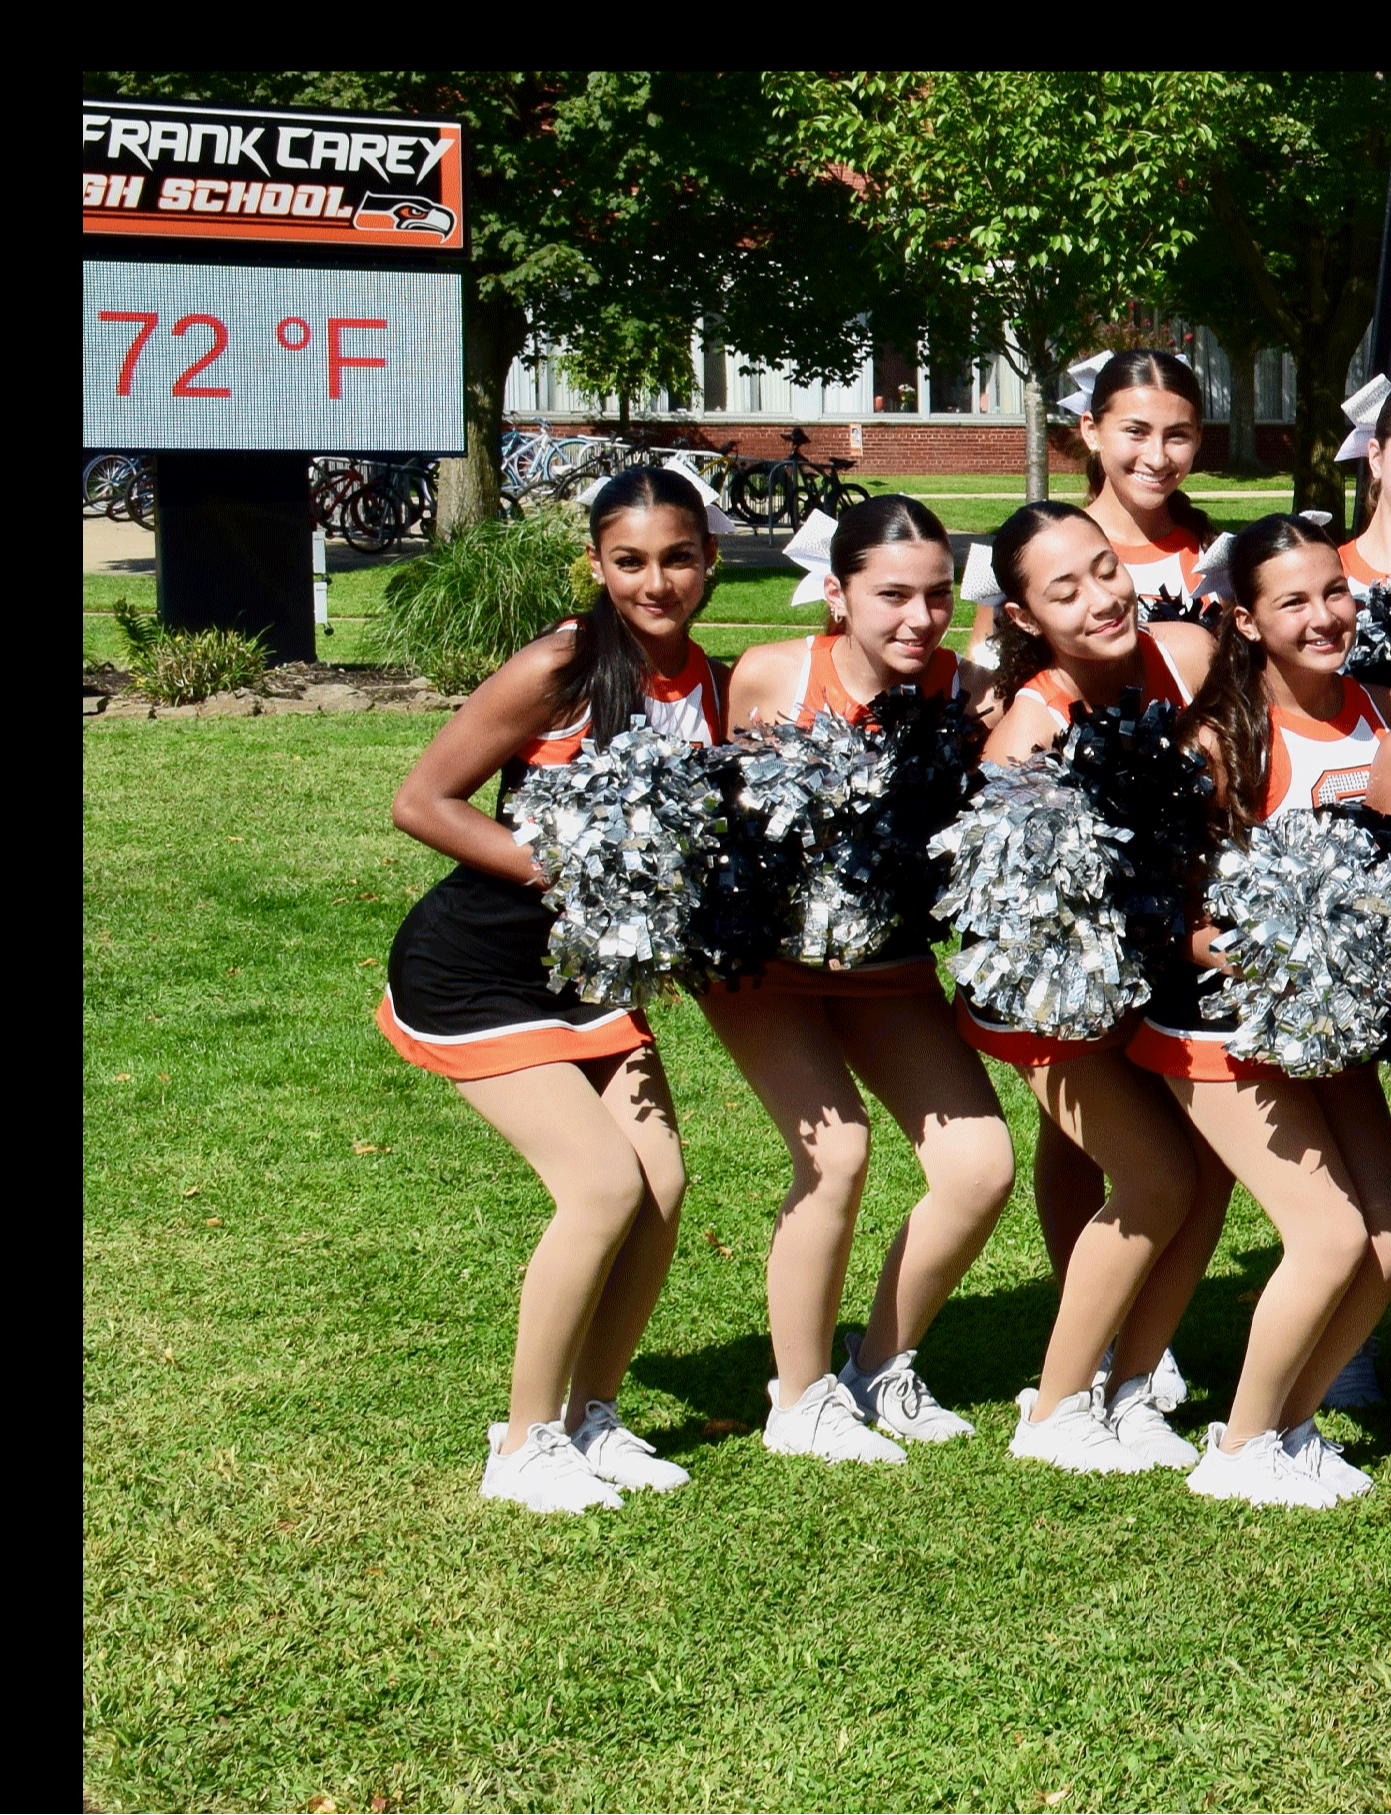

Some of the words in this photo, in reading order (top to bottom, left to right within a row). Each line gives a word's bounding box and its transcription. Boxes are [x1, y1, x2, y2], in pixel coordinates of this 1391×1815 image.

[83, 114, 271, 178] FRANK
[276, 126, 456, 186] CAREY
[158, 177, 353, 218] SCHOOL
[99, 310, 231, 397] 72
[277, 317, 388, 399] °F
